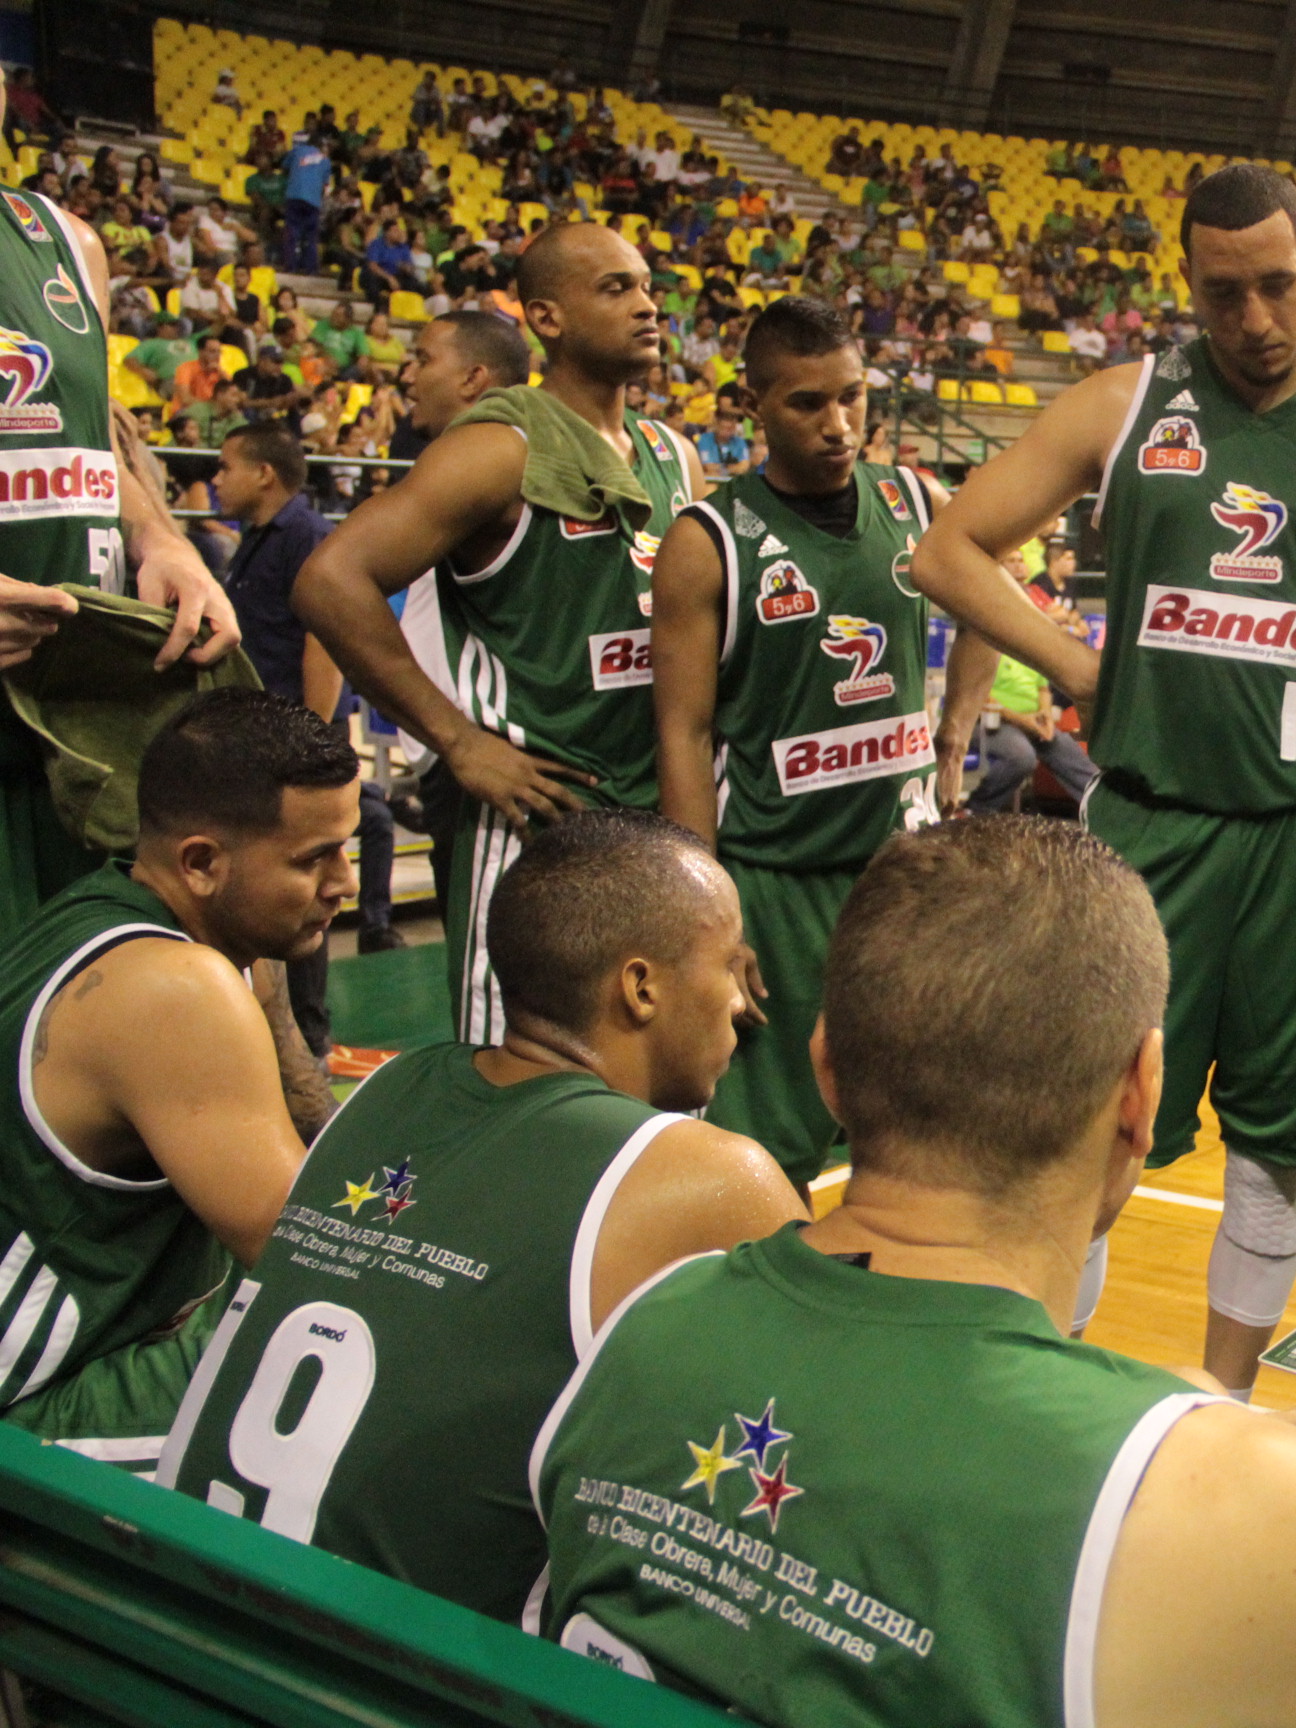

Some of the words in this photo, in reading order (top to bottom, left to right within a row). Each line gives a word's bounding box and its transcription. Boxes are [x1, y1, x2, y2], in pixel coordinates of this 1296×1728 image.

[0, 455, 115, 501] ndes
[785, 722, 930, 780] Bandes
[367, 1255, 381, 1268] y
[382, 1255, 446, 1288] Comunas
[382, 1234, 414, 1255] DEL
[414, 1242, 489, 1280] PUEBLO
[308, 1323, 347, 1343] BORDÓ
[609, 1515, 648, 1549] Clase
[651, 1531, 714, 1581] Obrera,
[716, 1561, 763, 1600] Mujer
[759, 1590, 778, 1613] y
[779, 1594, 876, 1663] Comunas
[616, 1485, 774, 1571] BICENTENARIO
[774, 1552, 818, 1596] DEL
[823, 1578, 935, 1657] PUEBLO
[639, 1563, 695, 1596] BANCO
